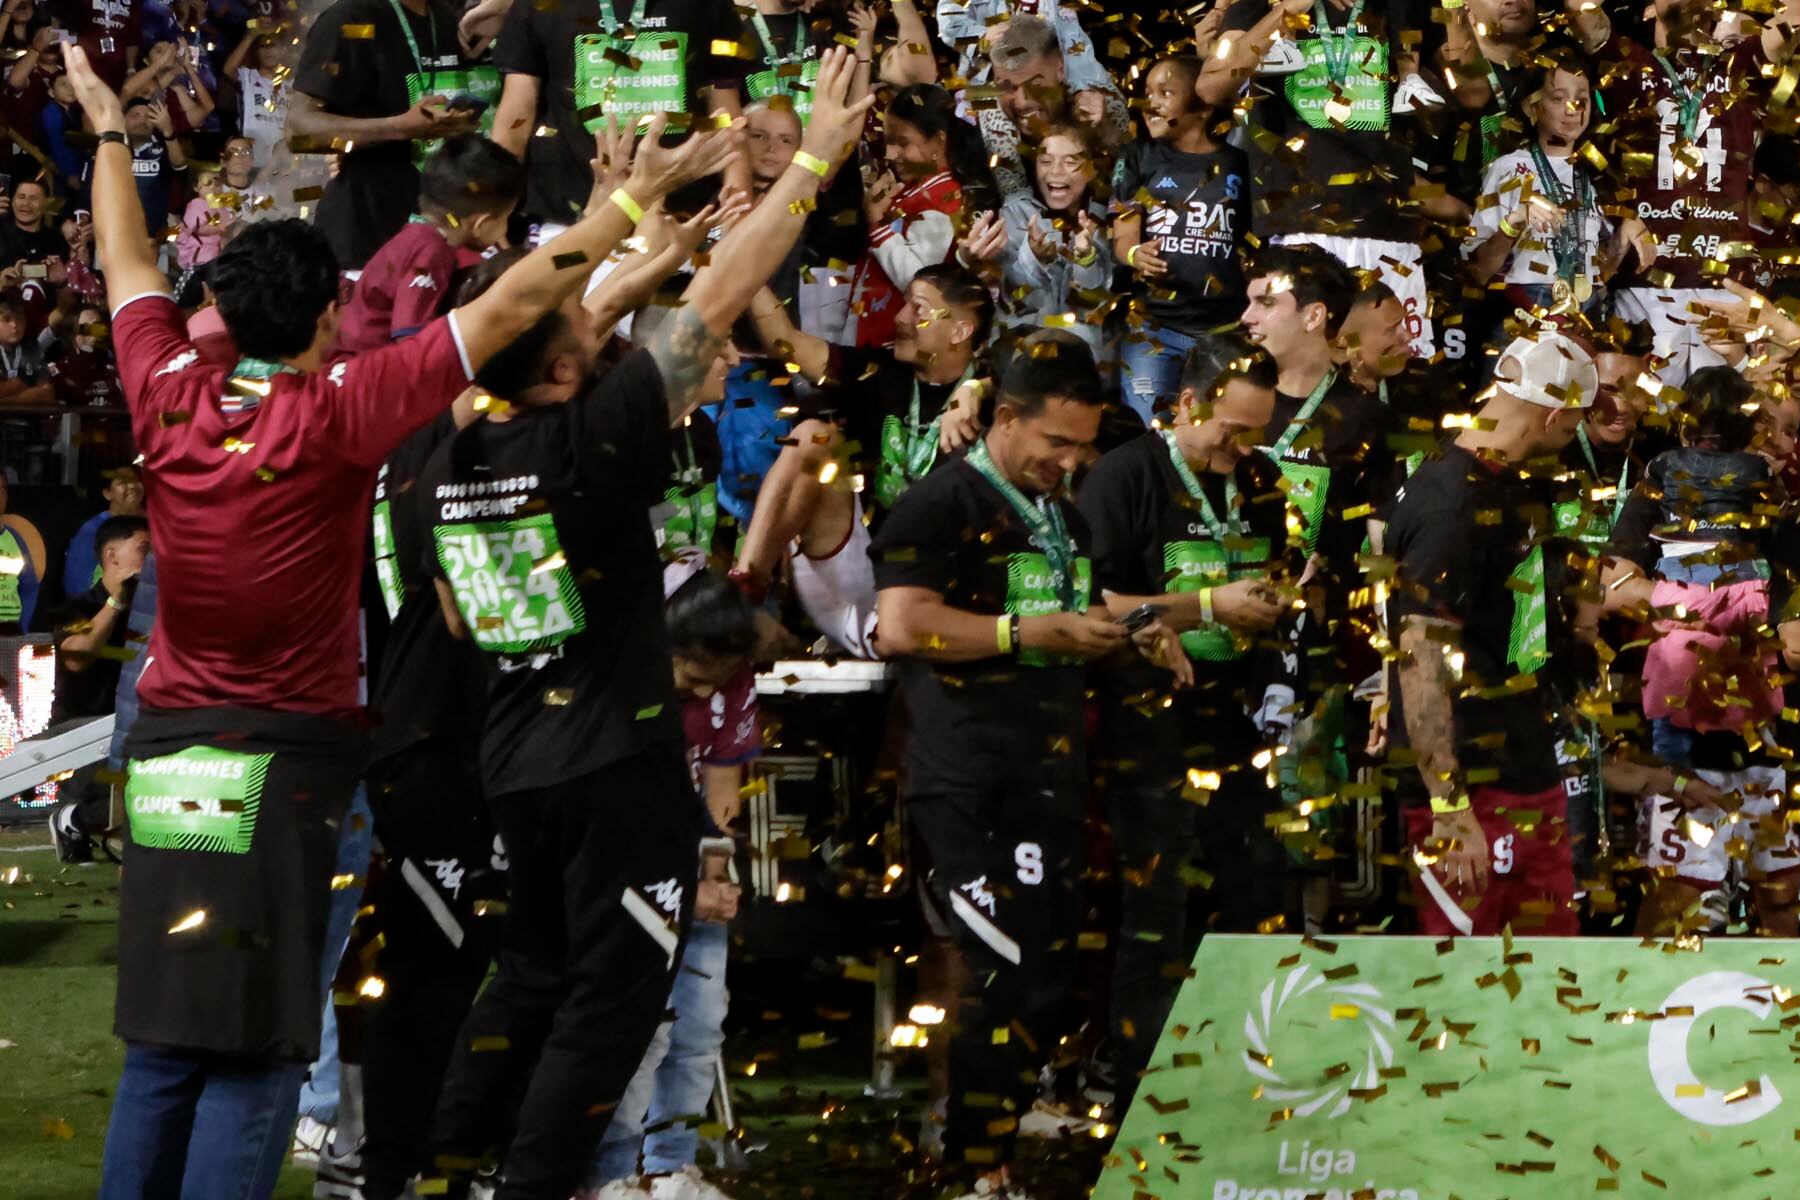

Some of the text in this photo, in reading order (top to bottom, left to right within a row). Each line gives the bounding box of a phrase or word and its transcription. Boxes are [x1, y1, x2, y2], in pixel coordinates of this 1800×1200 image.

[1187, 201, 1236, 234] BAC
[1154, 235, 1233, 260] IBERTY
[1444, 328, 1467, 359] S
[1015, 841, 1044, 885] S
[1493, 834, 1514, 875] S
[1661, 829, 1687, 863] S
[1277, 1140, 1357, 1183] Liga
